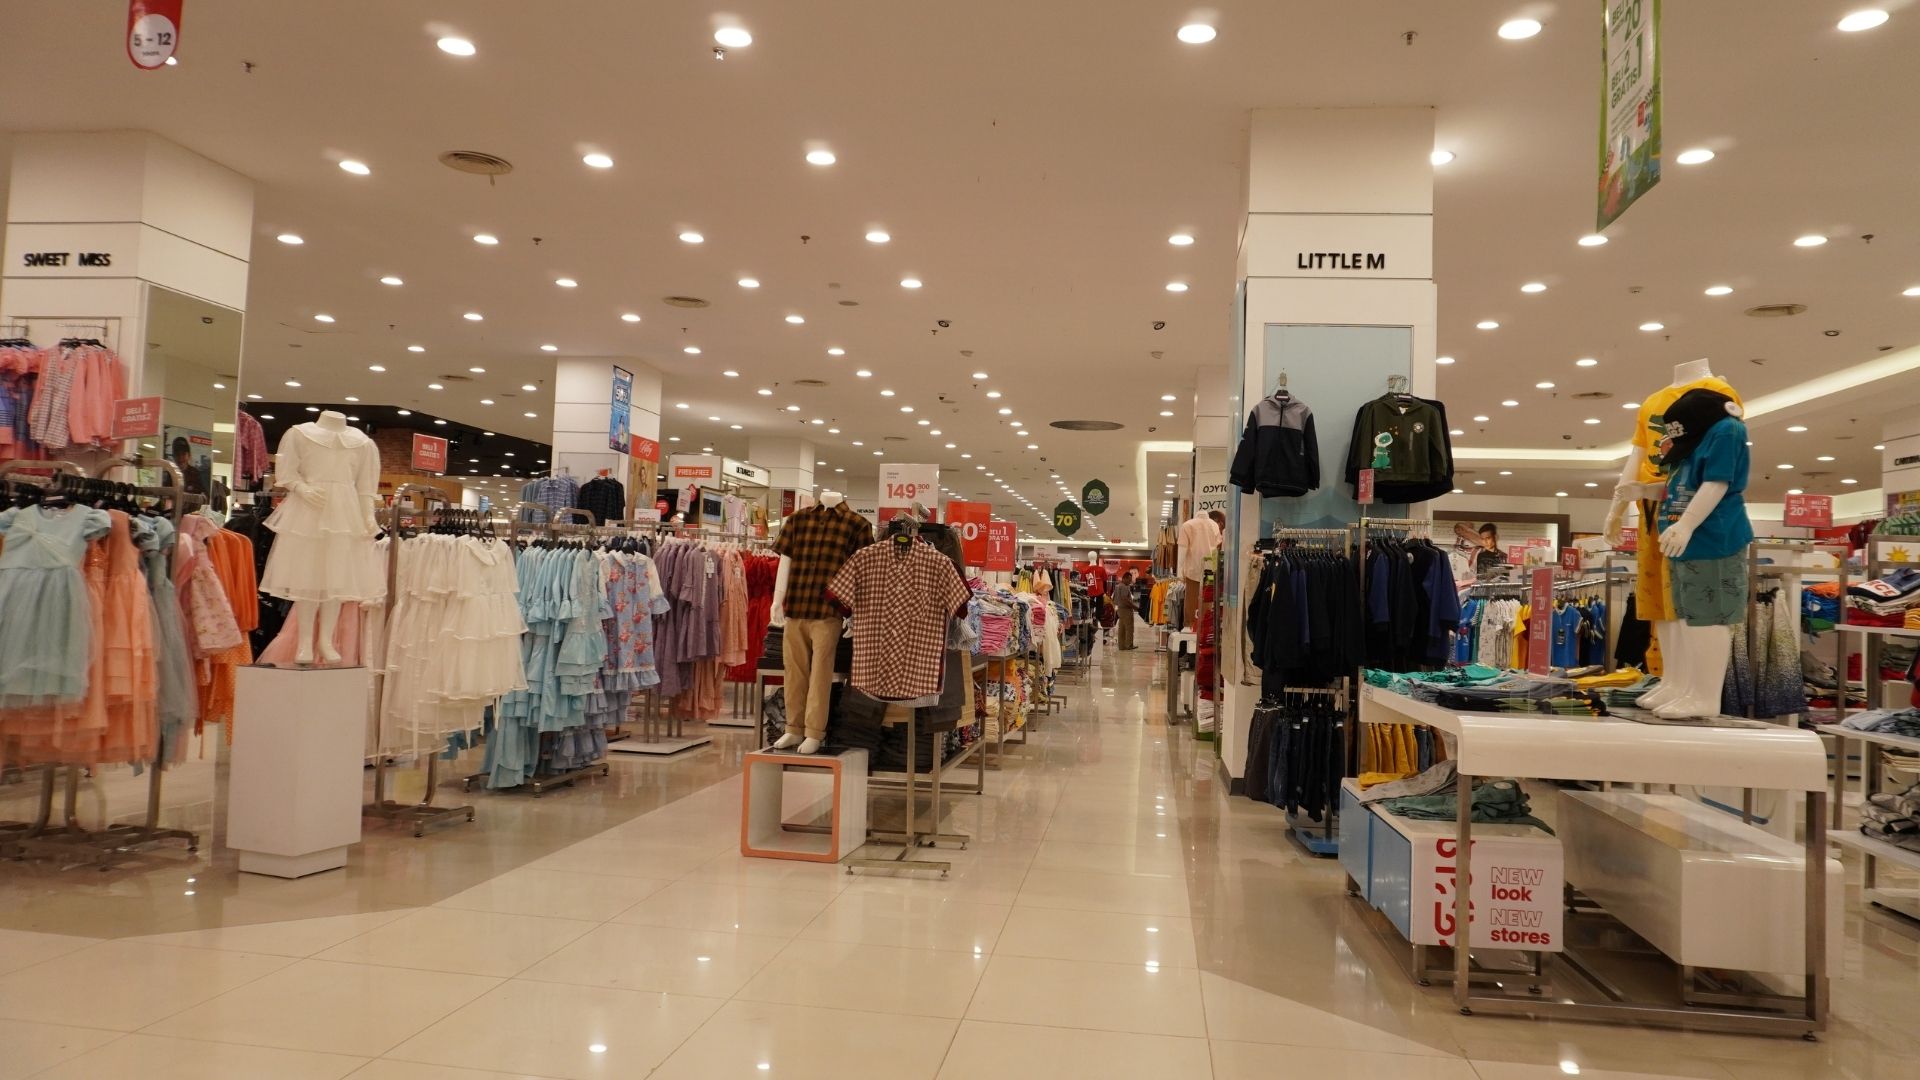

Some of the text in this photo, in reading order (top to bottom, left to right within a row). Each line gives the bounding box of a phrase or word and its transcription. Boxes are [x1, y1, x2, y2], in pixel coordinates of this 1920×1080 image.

[134, 34, 142, 47] 5
[157, 32, 171, 46] 12
[1625, 49, 1630, 75] 2
[1611, 67, 1638, 109] GRATIS
[24, 252, 112, 267] SWEET MISS
[1298, 253, 1385, 269] LITTLE M
[887, 483, 916, 499] 149
[1002, 521, 1007, 535] 1
[995, 540, 1000, 553] 1
[1491, 866, 1543, 886] NEW
[1491, 885, 1532, 902] look
[1491, 908, 1543, 928] NEW
[1491, 928, 1550, 945] stores
